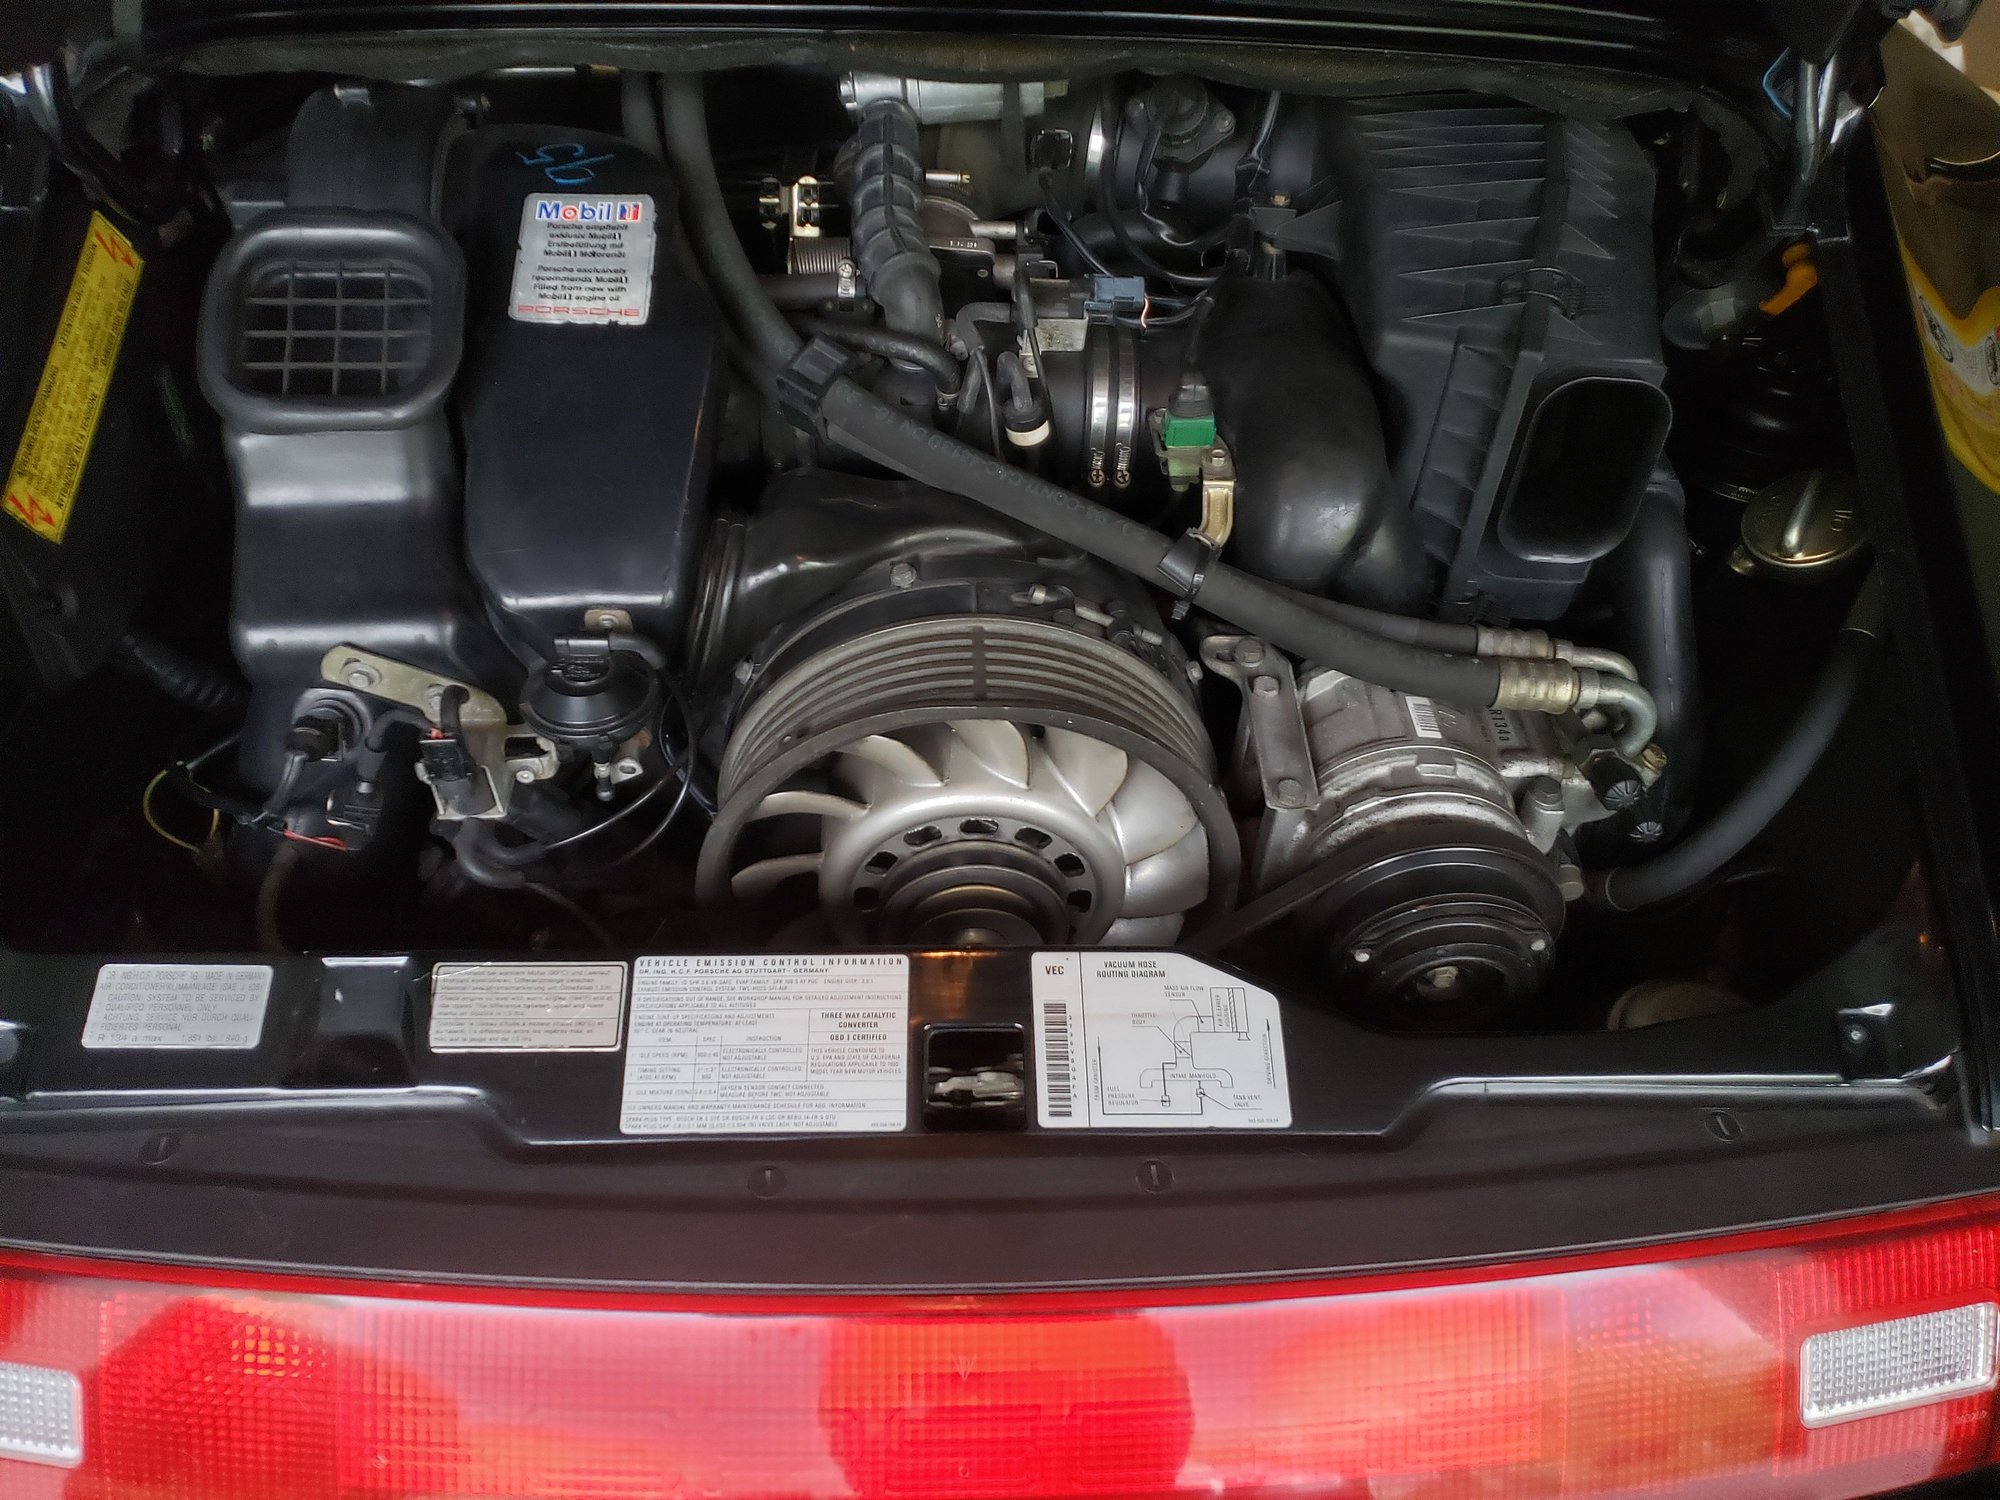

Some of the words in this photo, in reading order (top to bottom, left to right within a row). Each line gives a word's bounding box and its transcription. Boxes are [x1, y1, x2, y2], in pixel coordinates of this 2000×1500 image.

[537, 201, 612, 221] Mobil
[537, 265, 574, 273] Porsche
[518, 305, 640, 317] PORSCHE
[639, 959, 689, 967] VEHICLE
[696, 958, 755, 967] EMISSION
[763, 958, 815, 966] CONTROL
[822, 957, 902, 966] INFORMATION
[1045, 965, 1065, 975] VEC
[1096, 970, 1129, 978] ROUTING
[1131, 970, 1166, 978] DIAGRAM
[197, 1003, 216, 1011] ONLY
